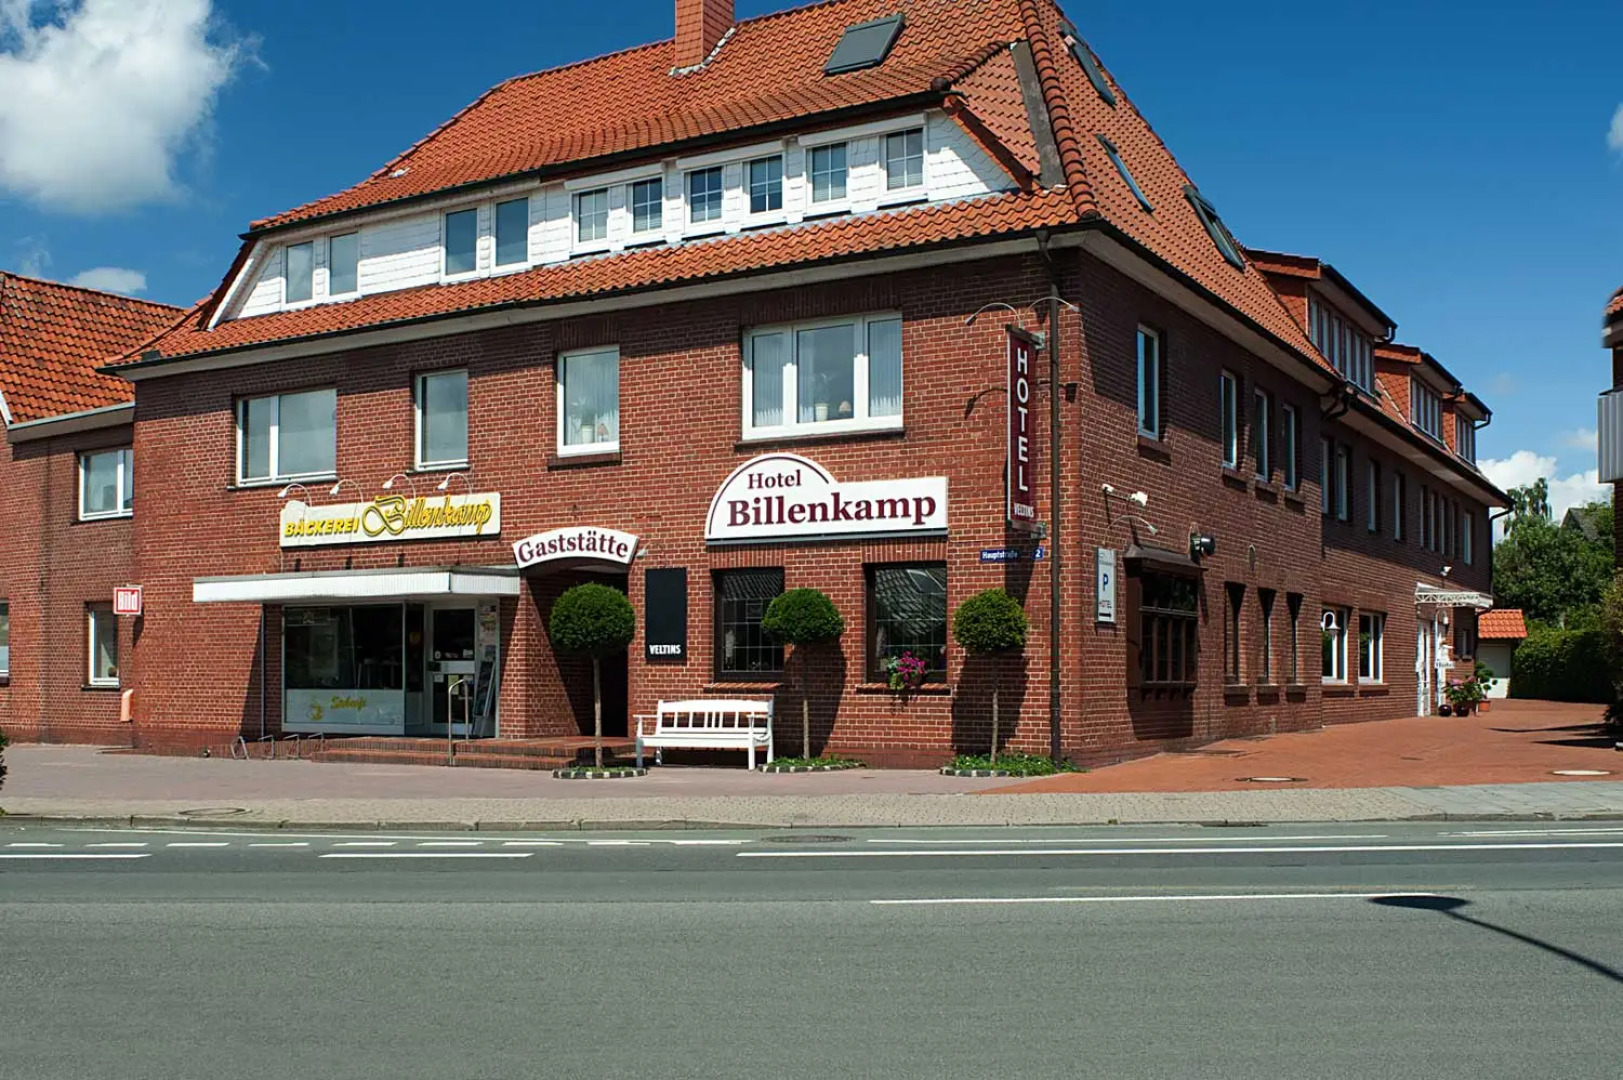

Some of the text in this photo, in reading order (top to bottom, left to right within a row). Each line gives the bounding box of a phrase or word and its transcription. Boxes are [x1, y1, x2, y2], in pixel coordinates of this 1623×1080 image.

[1016, 347, 1029, 492] HOTEL
[747, 470, 801, 490] Hotel
[283, 494, 492, 538] BÄCKEREI Billenkamp
[726, 491, 936, 527] Billenkamp
[518, 529, 629, 564] Gaststätte
[1035, 549, 1041, 558] 2
[1102, 573, 1109, 591] P
[649, 643, 682, 656] VELTINS
